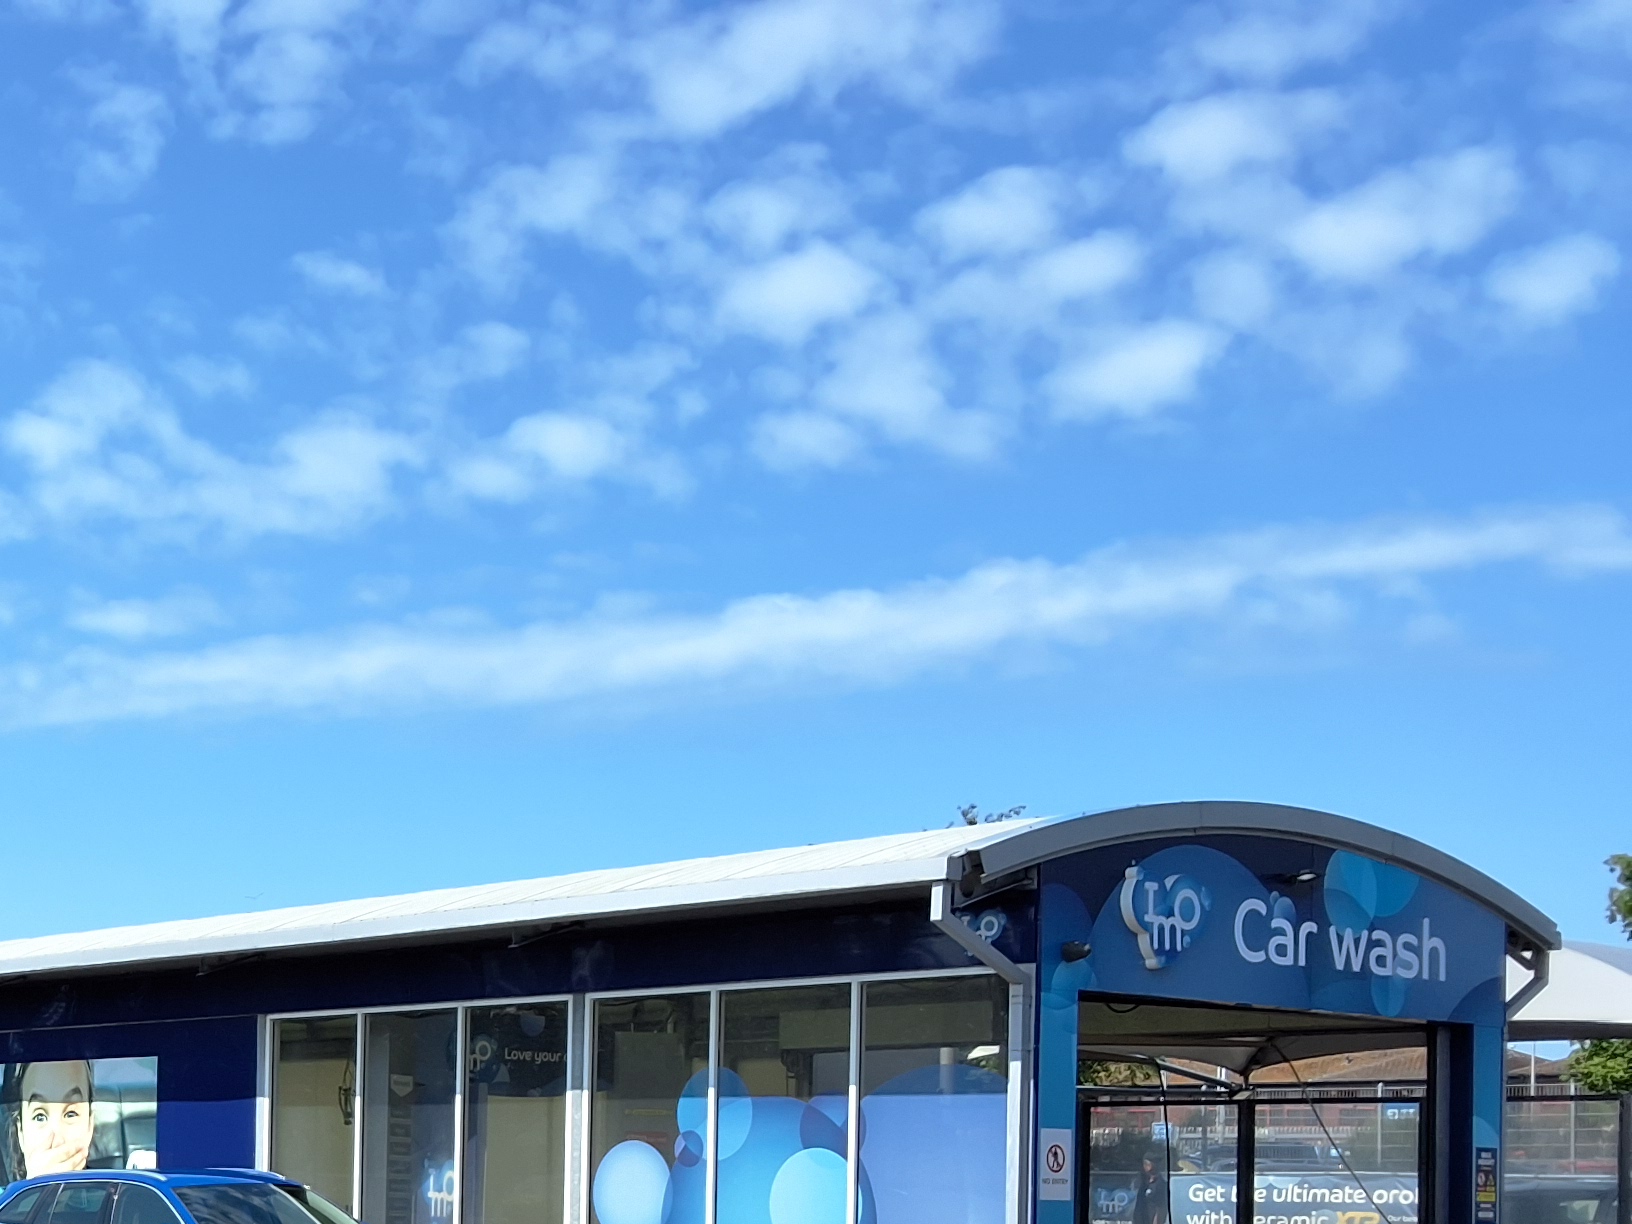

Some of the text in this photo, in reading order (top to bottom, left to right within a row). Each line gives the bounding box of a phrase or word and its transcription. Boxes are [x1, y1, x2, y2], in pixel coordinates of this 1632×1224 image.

[1234, 898, 1447, 982] Car wash
[504, 1047, 532, 1061] Love
[535, 1051, 562, 1065] your
[1188, 1184, 1226, 1203] Get
[1272, 1183, 1367, 1204] ultimate
